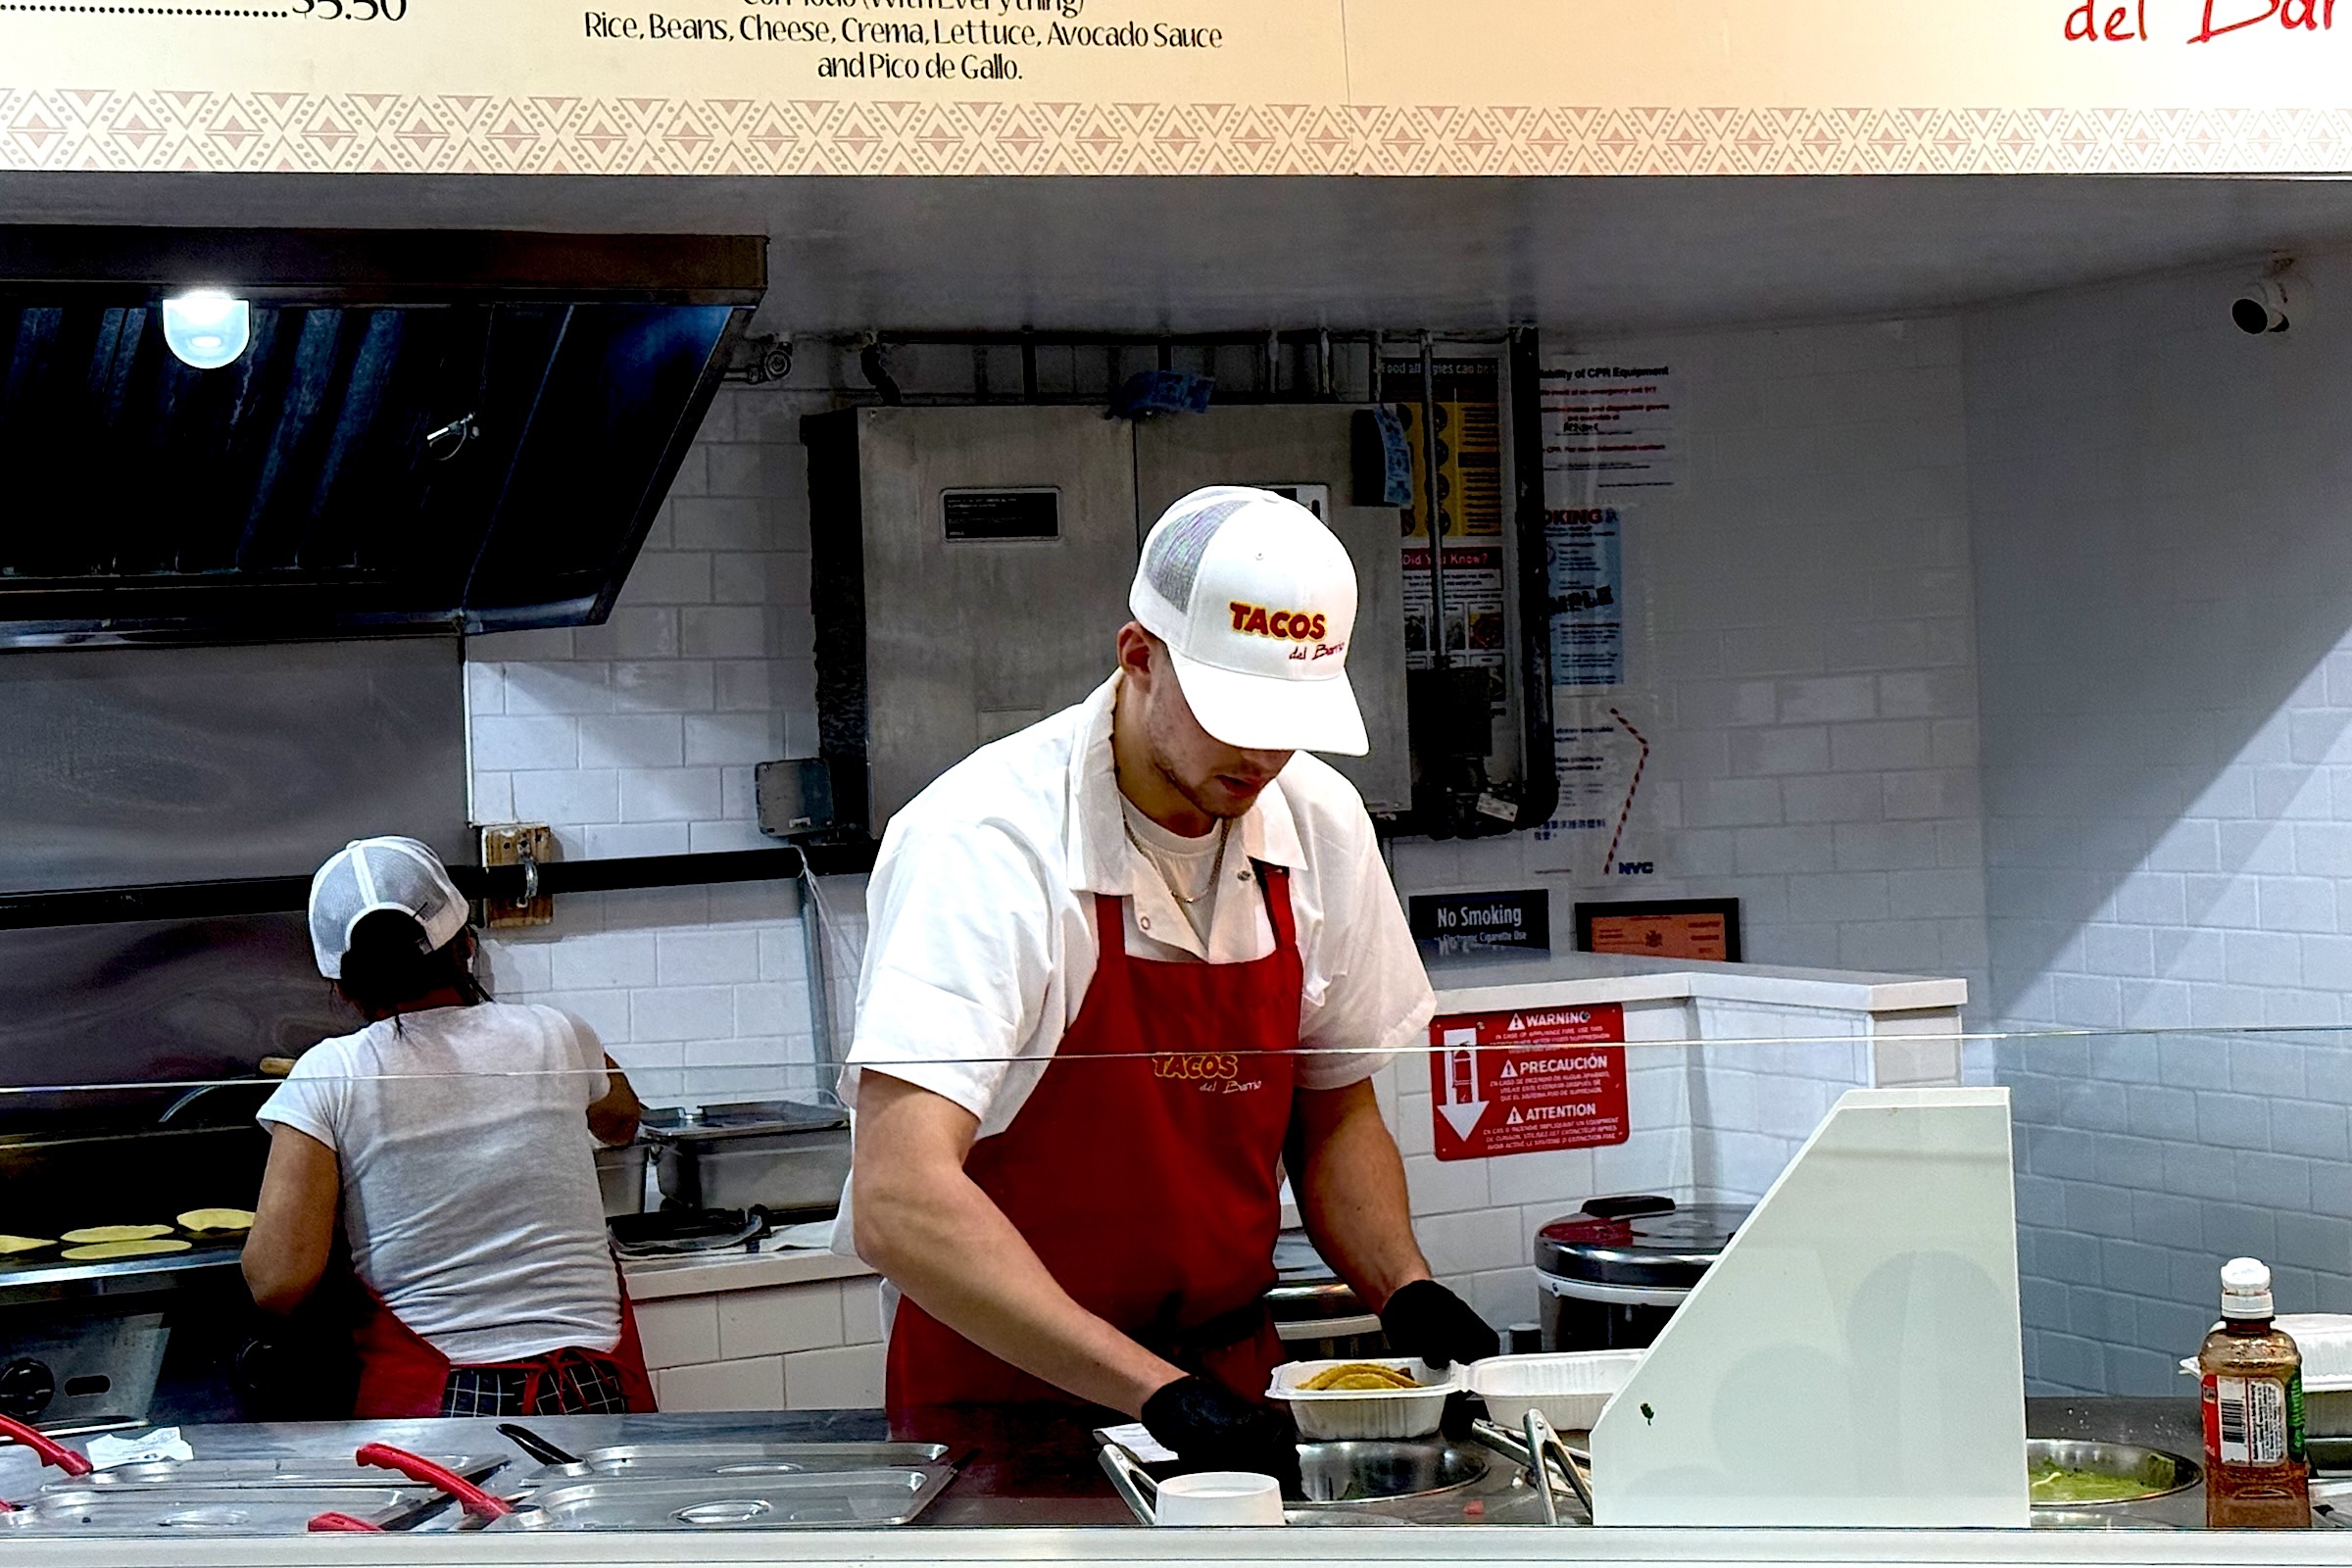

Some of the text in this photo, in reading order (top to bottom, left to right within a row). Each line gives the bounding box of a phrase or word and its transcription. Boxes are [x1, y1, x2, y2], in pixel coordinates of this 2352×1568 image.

[585, 12, 1223, 49] Rice, Beans, Cheese, Crema, Lettuce, Avocado Sauce
[2065, 0, 2147, 41] del
[817, 51, 1023, 79] and Pico de Gallo.
[1588, 368, 1611, 378] CPR
[1613, 366, 1669, 379] Equipment
[1402, 554, 1421, 565] Did
[1450, 552, 1489, 565] Know?
[1229, 601, 1327, 641] TACOS
[1619, 861, 1653, 875] NYC
[1438, 905, 1523, 928] No Smoking
[1526, 1010, 1592, 1028] WARNING
[1152, 1053, 1239, 1079] TACOS
[1520, 1053, 1608, 1076] PRECAUCIÓN
[1526, 1102, 1596, 1121] ATTENTION
